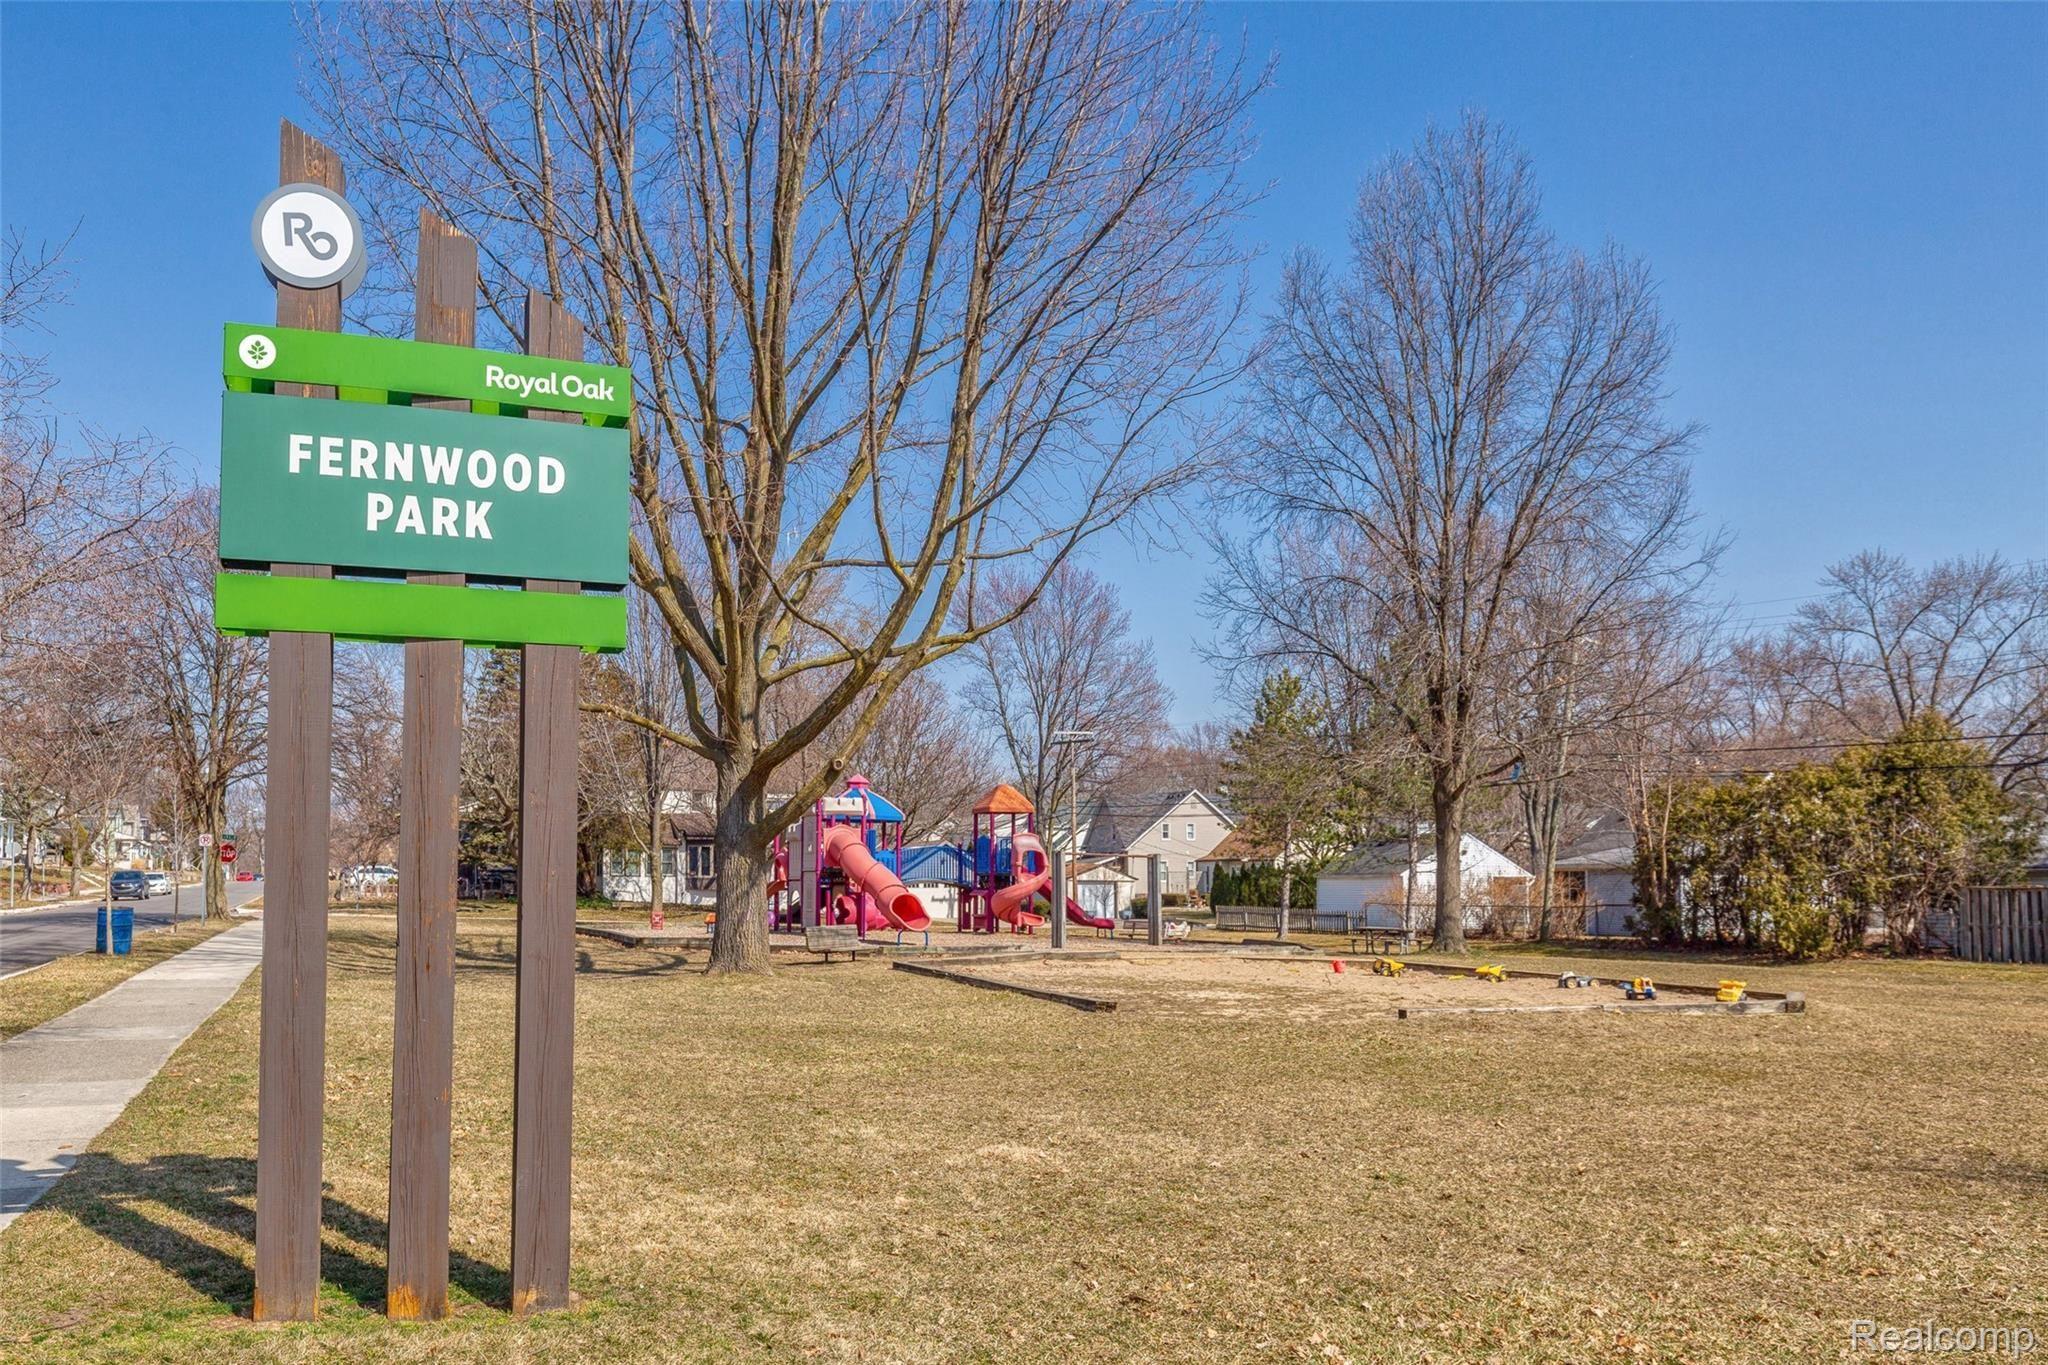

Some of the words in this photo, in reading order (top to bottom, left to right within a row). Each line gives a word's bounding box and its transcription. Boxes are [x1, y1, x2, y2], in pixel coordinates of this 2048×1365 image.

[486, 365, 558, 398] Royal
[560, 375, 614, 401] Oak
[289, 434, 566, 494] FERNWOOD
[366, 493, 494, 540] PARK
